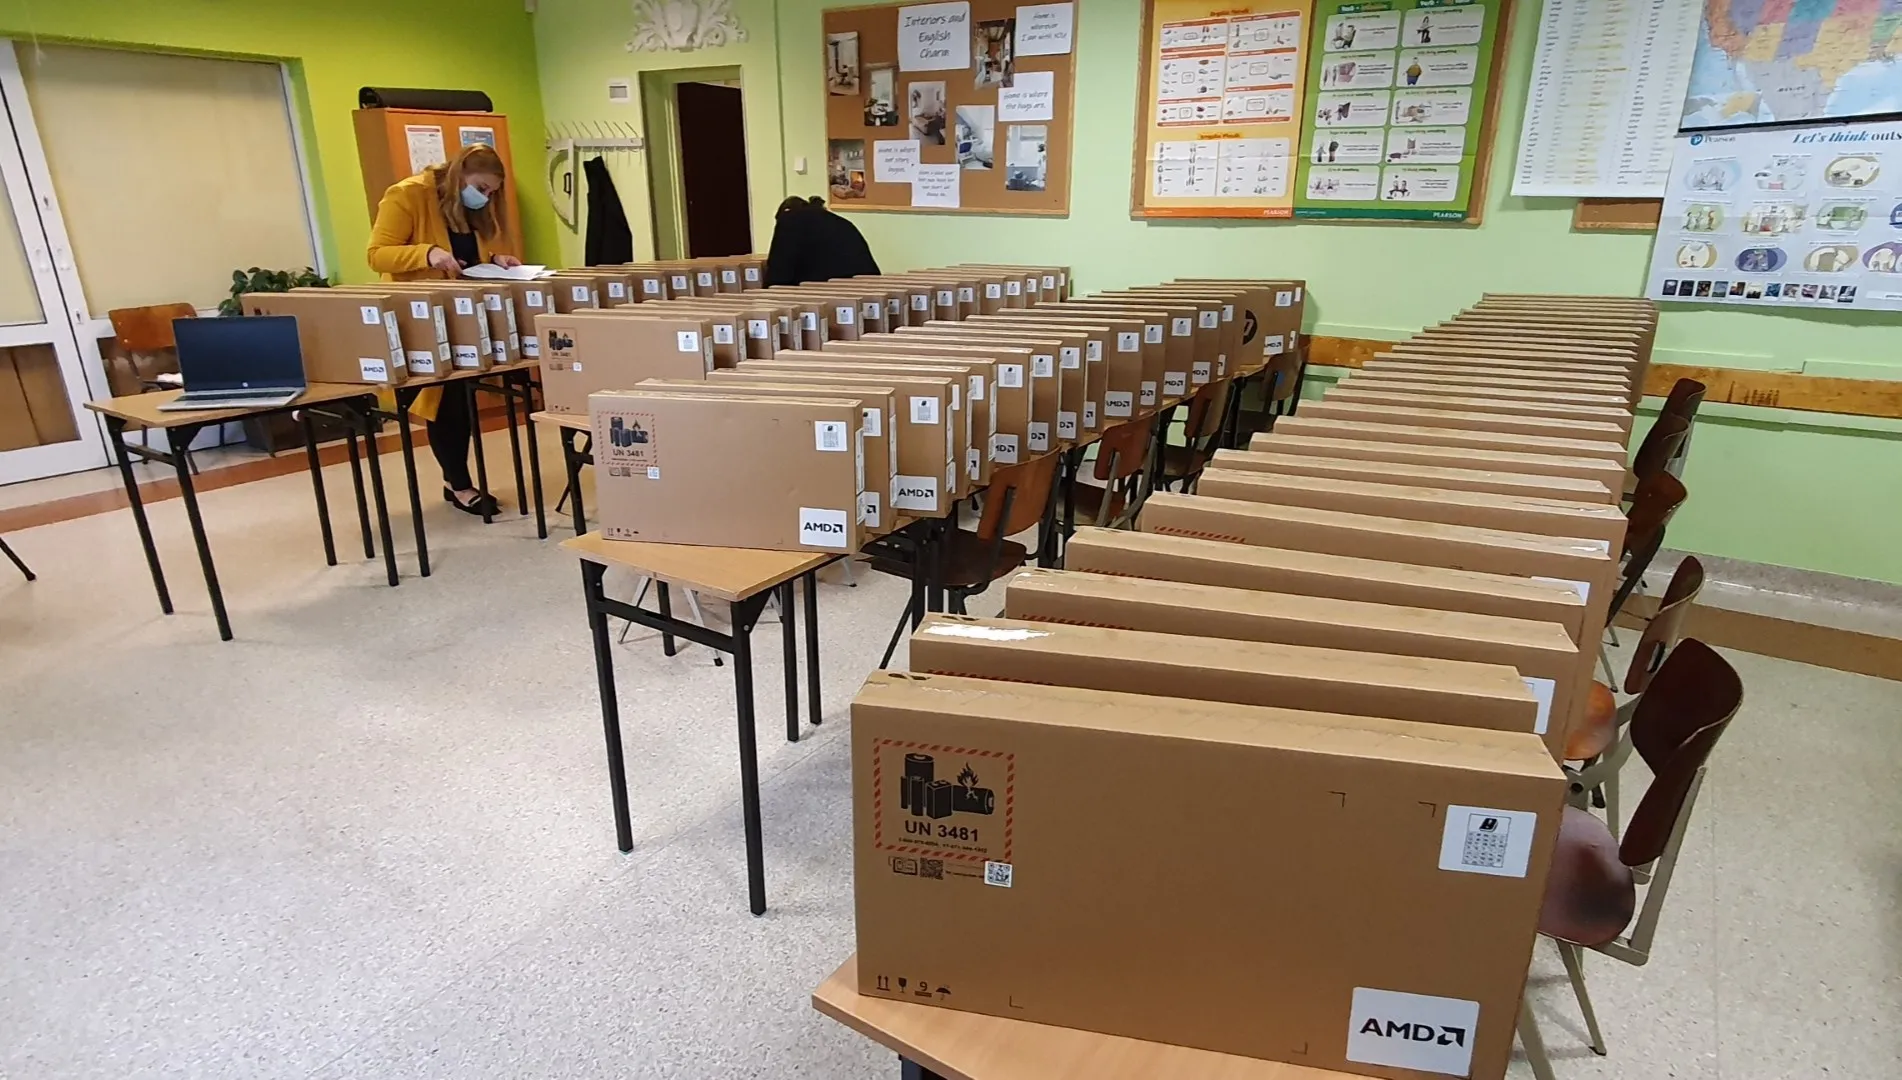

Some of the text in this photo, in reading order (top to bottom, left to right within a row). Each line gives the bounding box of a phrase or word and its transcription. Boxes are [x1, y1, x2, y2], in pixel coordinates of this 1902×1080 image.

[904, 11, 967, 28] Interiors and
[919, 30, 951, 46] English
[920, 48, 950, 59] Charm
[1793, 132, 1827, 144] Let's
[1829, 130, 1869, 142] think
[898, 487, 924, 498] AMD
[804, 521, 833, 533] AMD
[904, 819, 931, 837] UN
[937, 824, 979, 843] 3481
[1360, 1017, 1435, 1043] AMD
